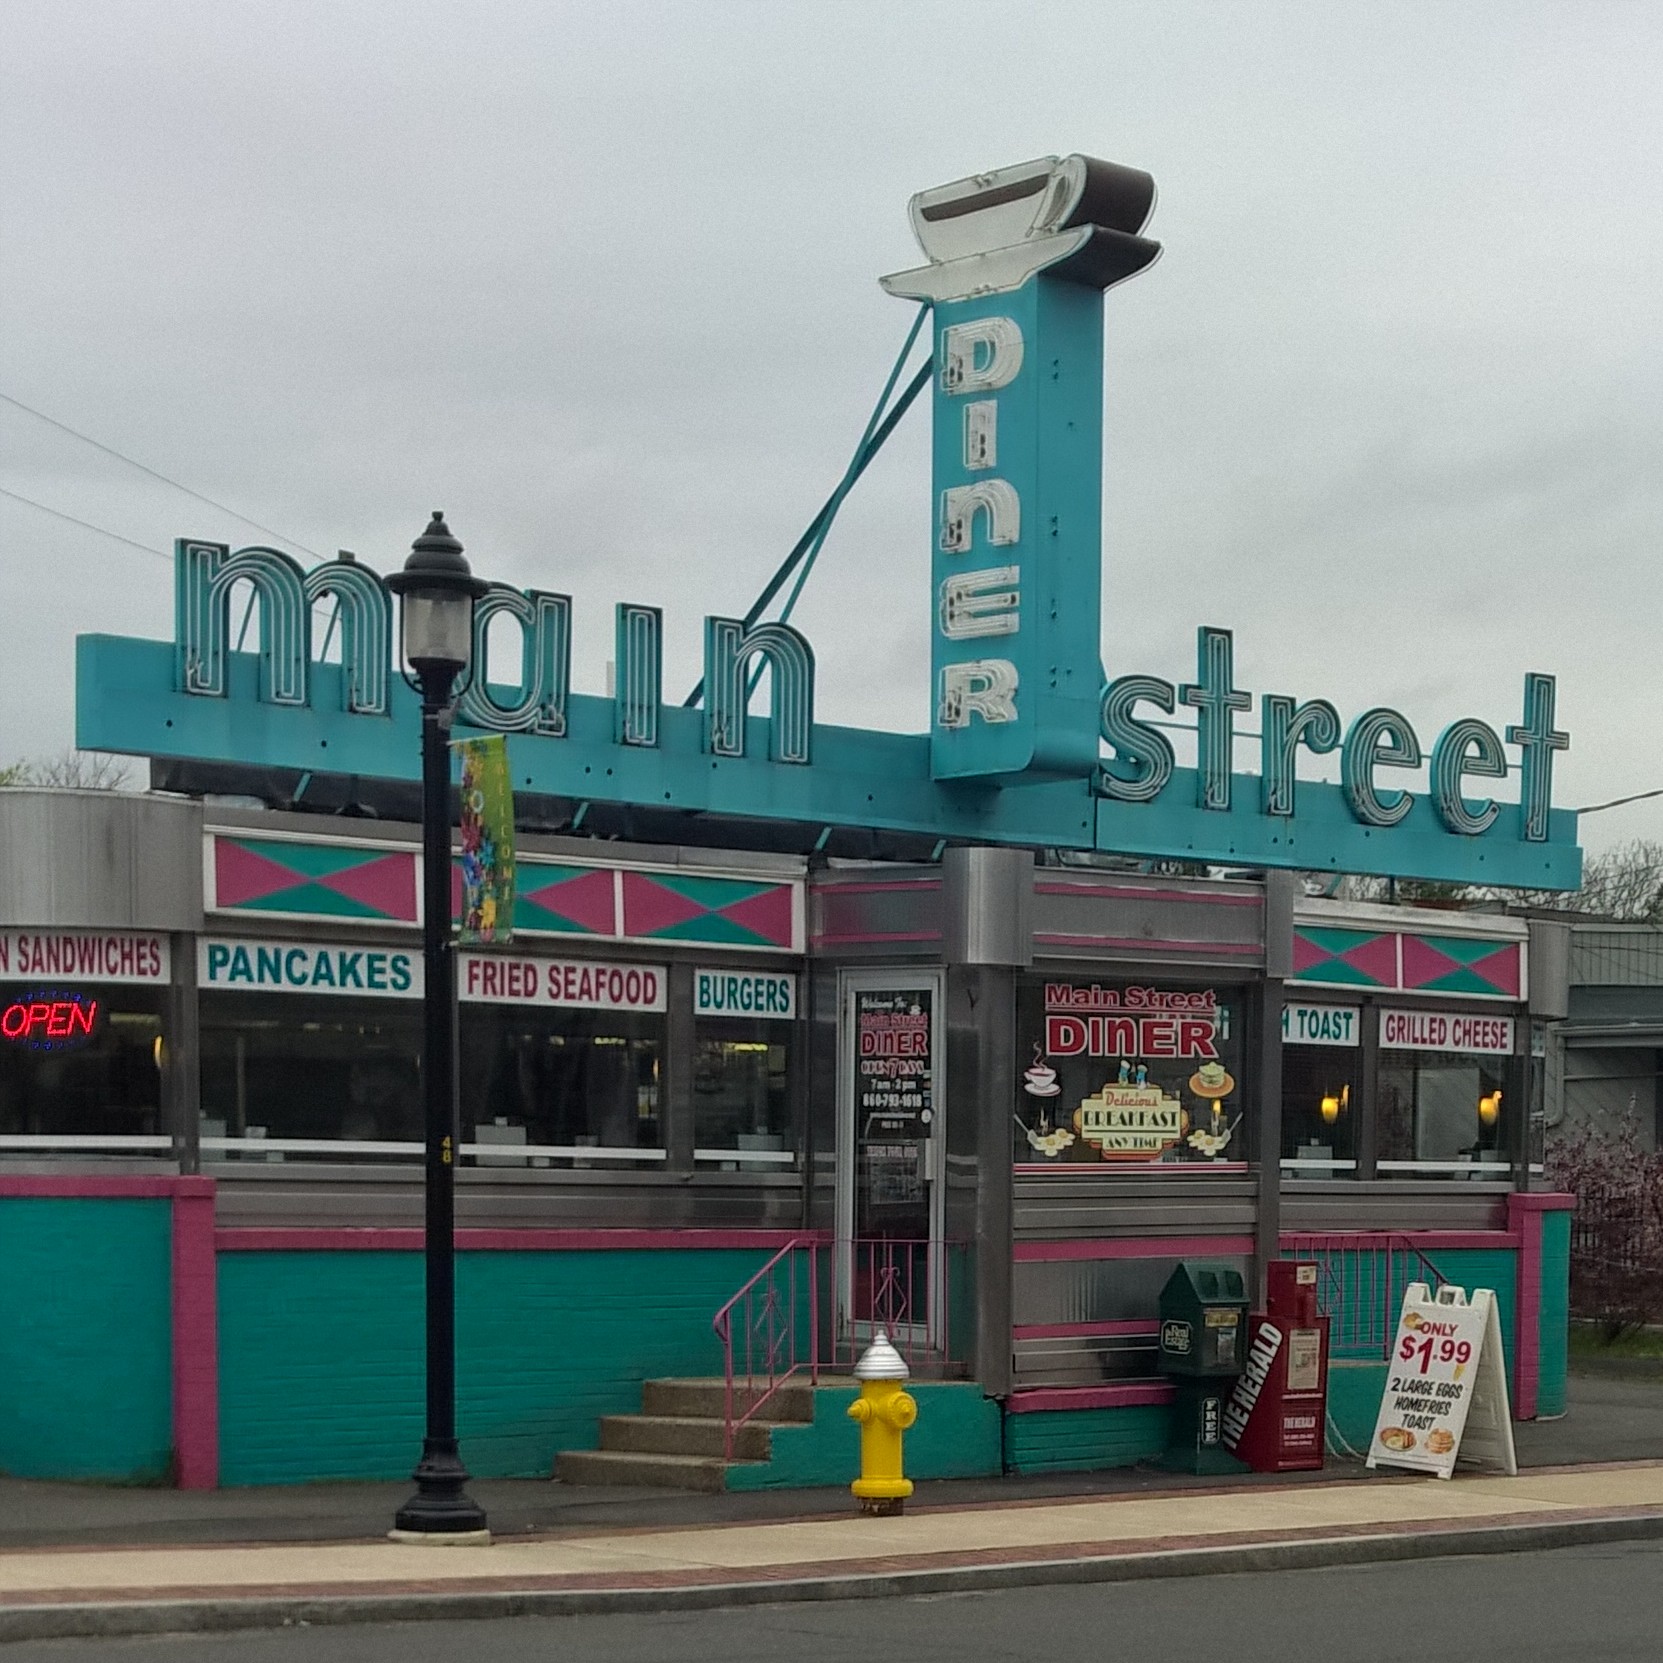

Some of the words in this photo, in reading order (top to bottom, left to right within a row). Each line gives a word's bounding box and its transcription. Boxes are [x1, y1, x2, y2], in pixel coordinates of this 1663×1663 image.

[1099, 625, 1569, 841] street
[18, 935, 161, 976] SANDWICHES
[208, 944, 412, 990] PANCAKES
[467, 960, 539, 997] FRIED
[549, 965, 657, 1005] SEAFOOD
[699, 975, 790, 1013] BURGERS
[1045, 984, 1120, 1006] Main
[1124, 986, 1216, 1010] Street
[1, 1000, 97, 1037] OPEN
[1297, 1009, 1353, 1040] TOAST
[1386, 1014, 1448, 1046] GRILLED
[1452, 1018, 1508, 1049] CHEESE
[1105, 1091, 1158, 1107] Delicious
[1083, 1111, 1178, 1127] BREAKFAST
[1420, 1321, 1459, 1337] ONLY
[1232, 1322, 1282, 1411] HERALD
[1399, 1335, 1472, 1375] $1.99
[1391, 1377, 1401, 1392] 2
[1401, 1378, 1435, 1396] LARGE
[1435, 1382, 1463, 1399] EGGS
[1393, 1395, 1452, 1416] HOMEFRIES
[1205, 1400, 1217, 1441] FREE
[1401, 1413, 1436, 1431] TOAST
